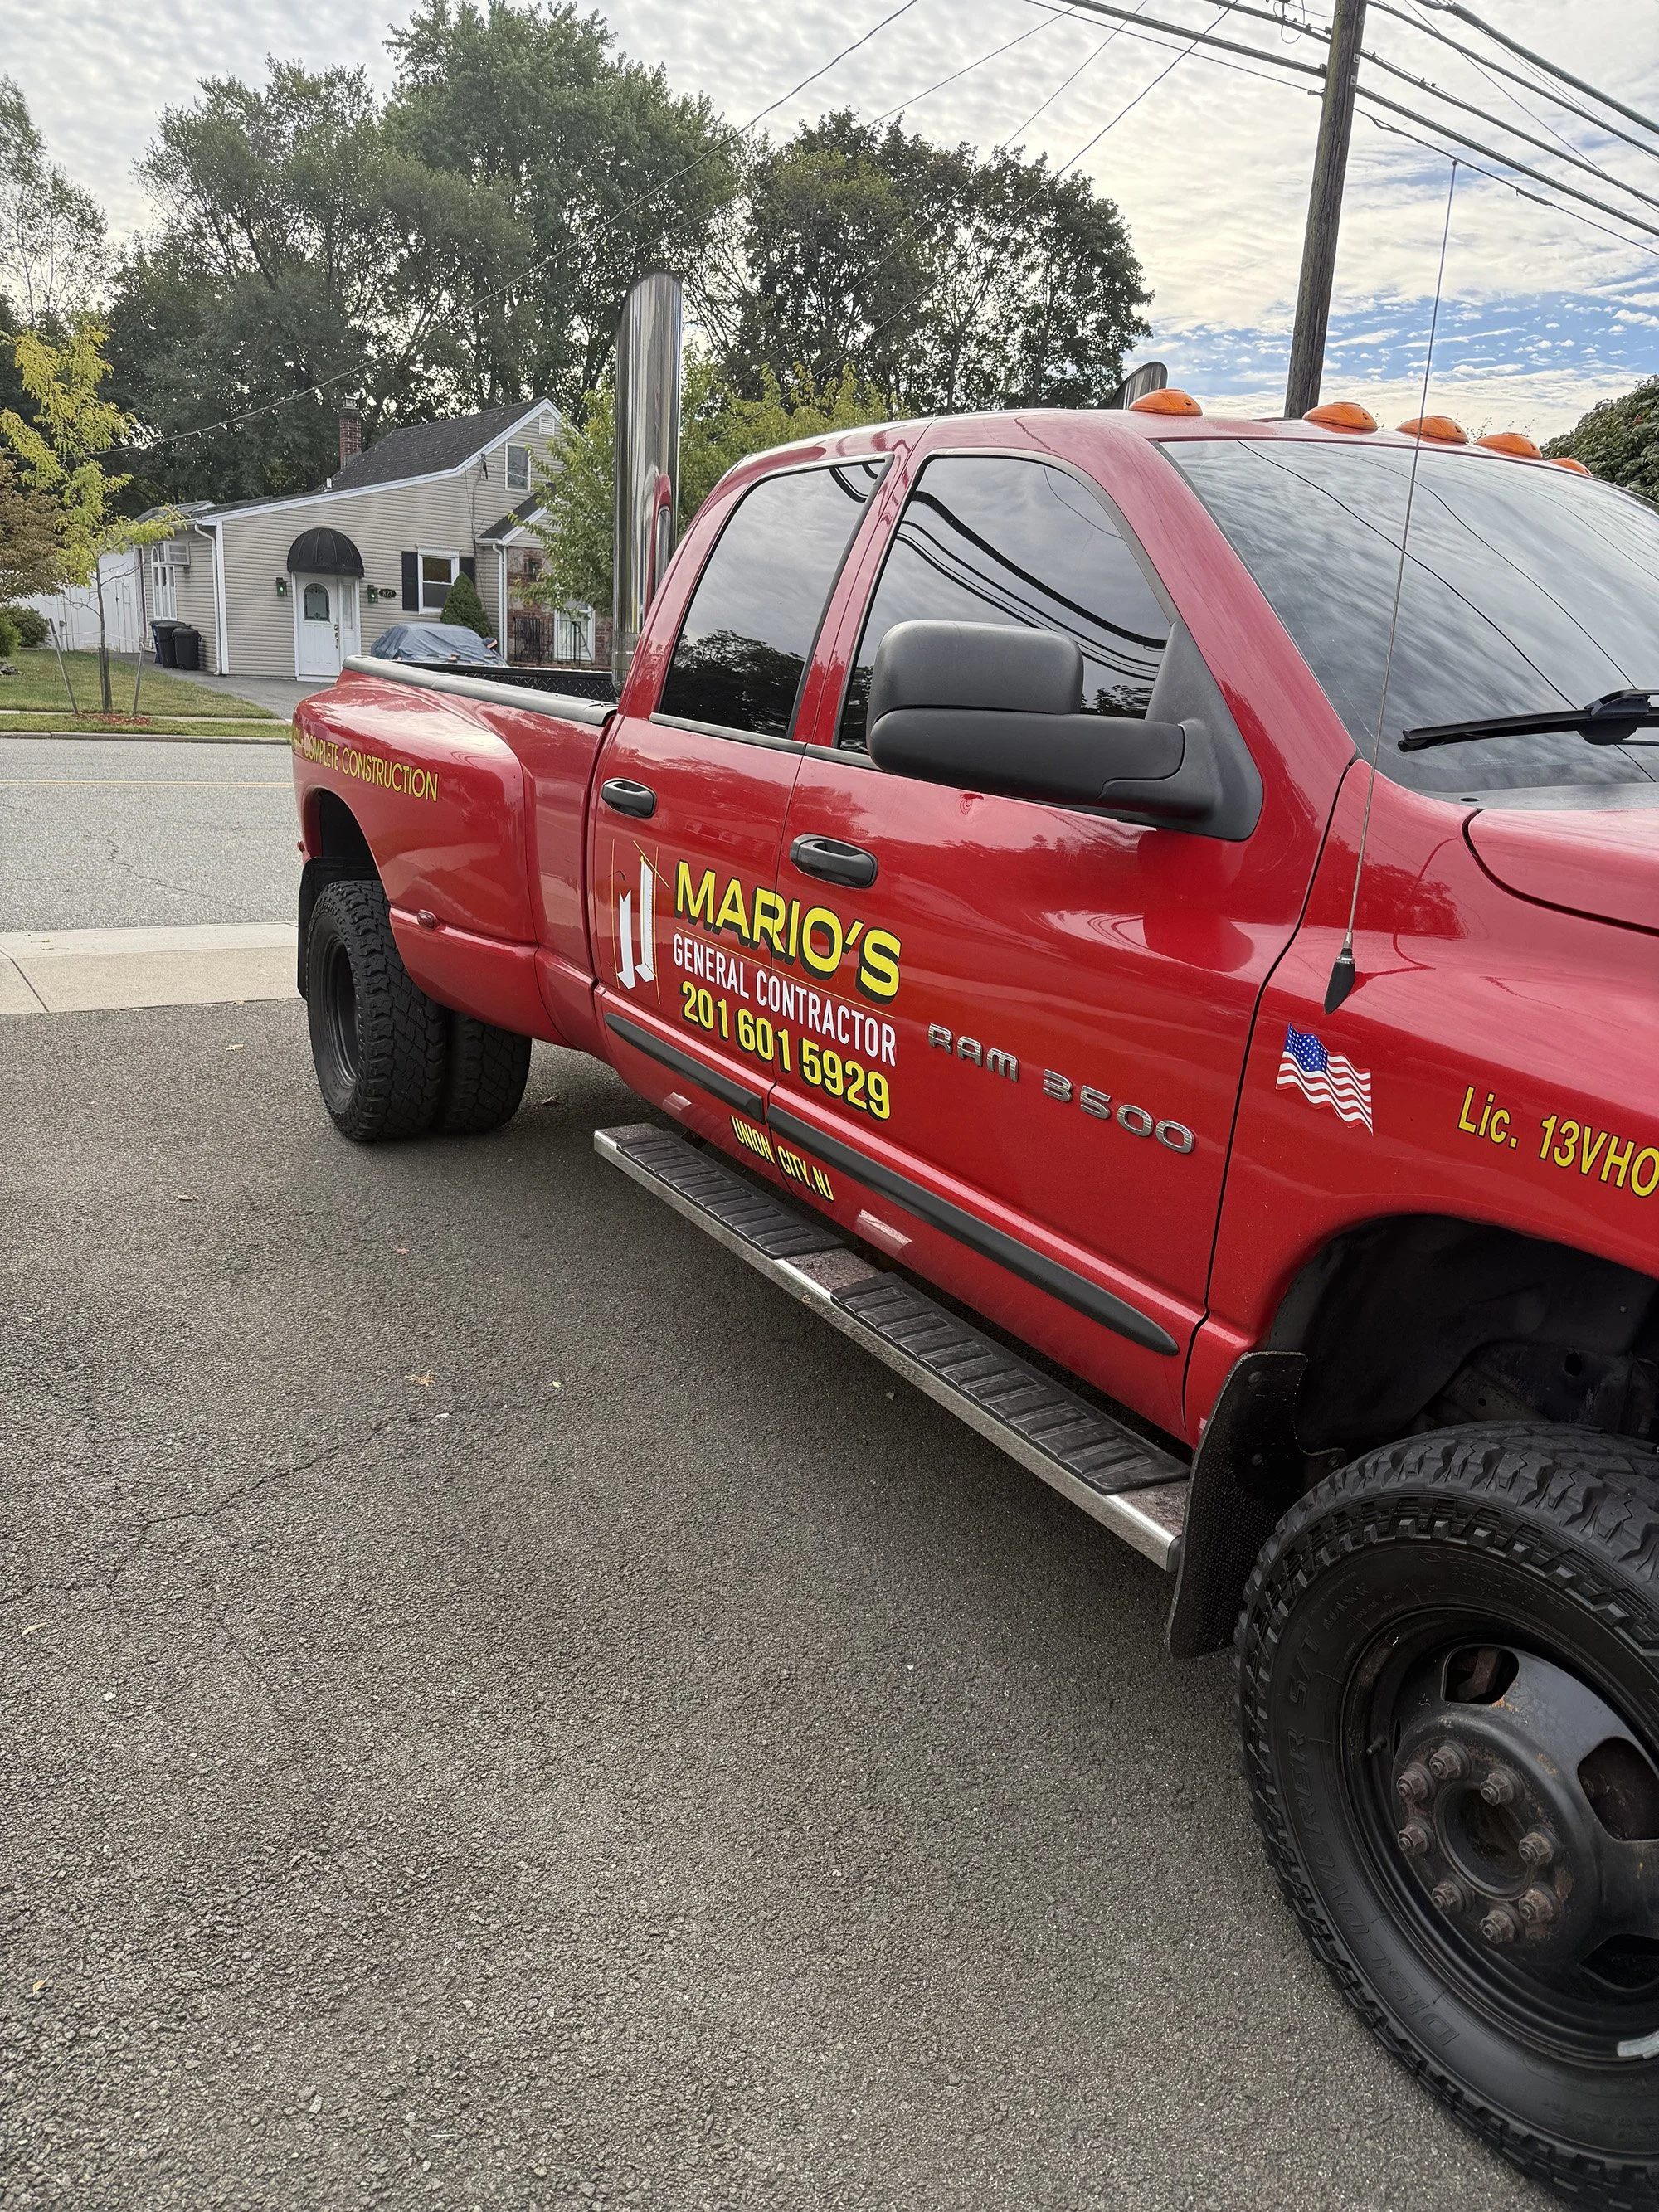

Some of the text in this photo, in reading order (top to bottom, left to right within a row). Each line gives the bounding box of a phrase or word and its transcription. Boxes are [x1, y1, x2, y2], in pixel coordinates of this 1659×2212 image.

[303, 732, 339, 771] COMPLETE
[342, 746, 439, 802] CONSTRUCTION
[674, 859, 902, 1004] MARIO'S
[673, 933, 896, 1067] GENERAL CONTRACTOR
[680, 980, 892, 1121] 201 601 5929
[730, 1114, 776, 1167] UNION
[927, 1023, 1195, 1154] RAM 3500
[1457, 1084, 1519, 1150] Lic.
